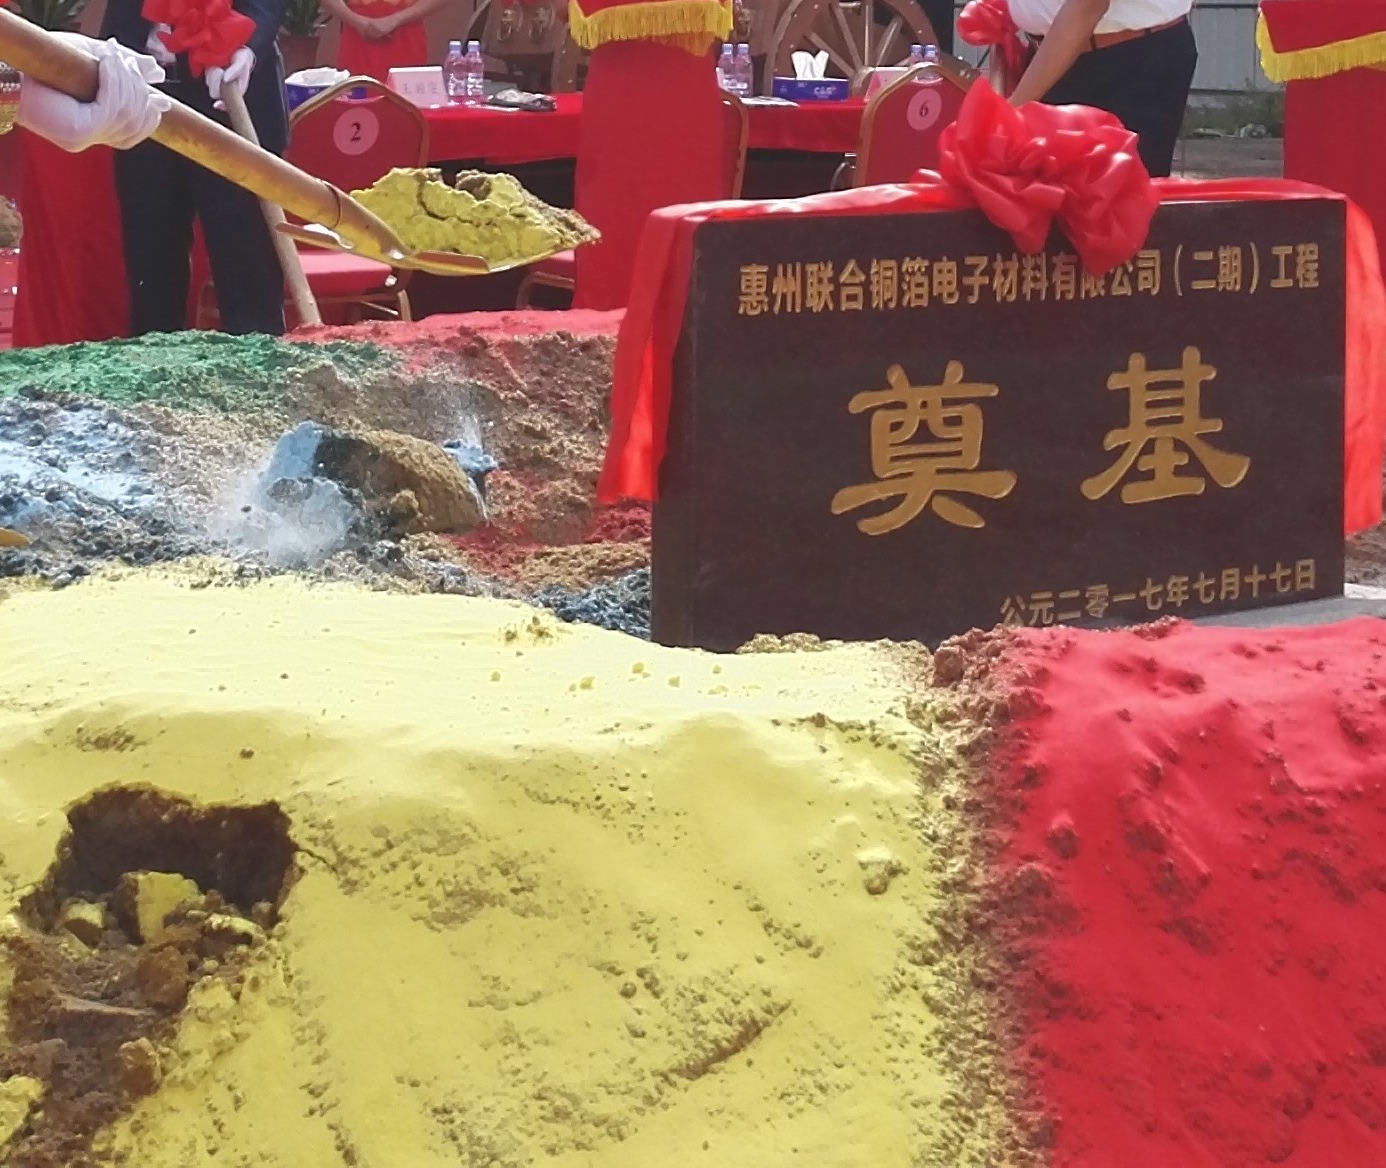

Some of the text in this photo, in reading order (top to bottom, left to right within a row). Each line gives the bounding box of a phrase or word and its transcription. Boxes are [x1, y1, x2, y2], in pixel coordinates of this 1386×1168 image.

[919, 100, 931, 117] 6
[350, 122, 362, 142] 2
[830, 345, 1251, 536] 奠基
[999, 558, 1316, 627] 公元二零一七年七月十七日
